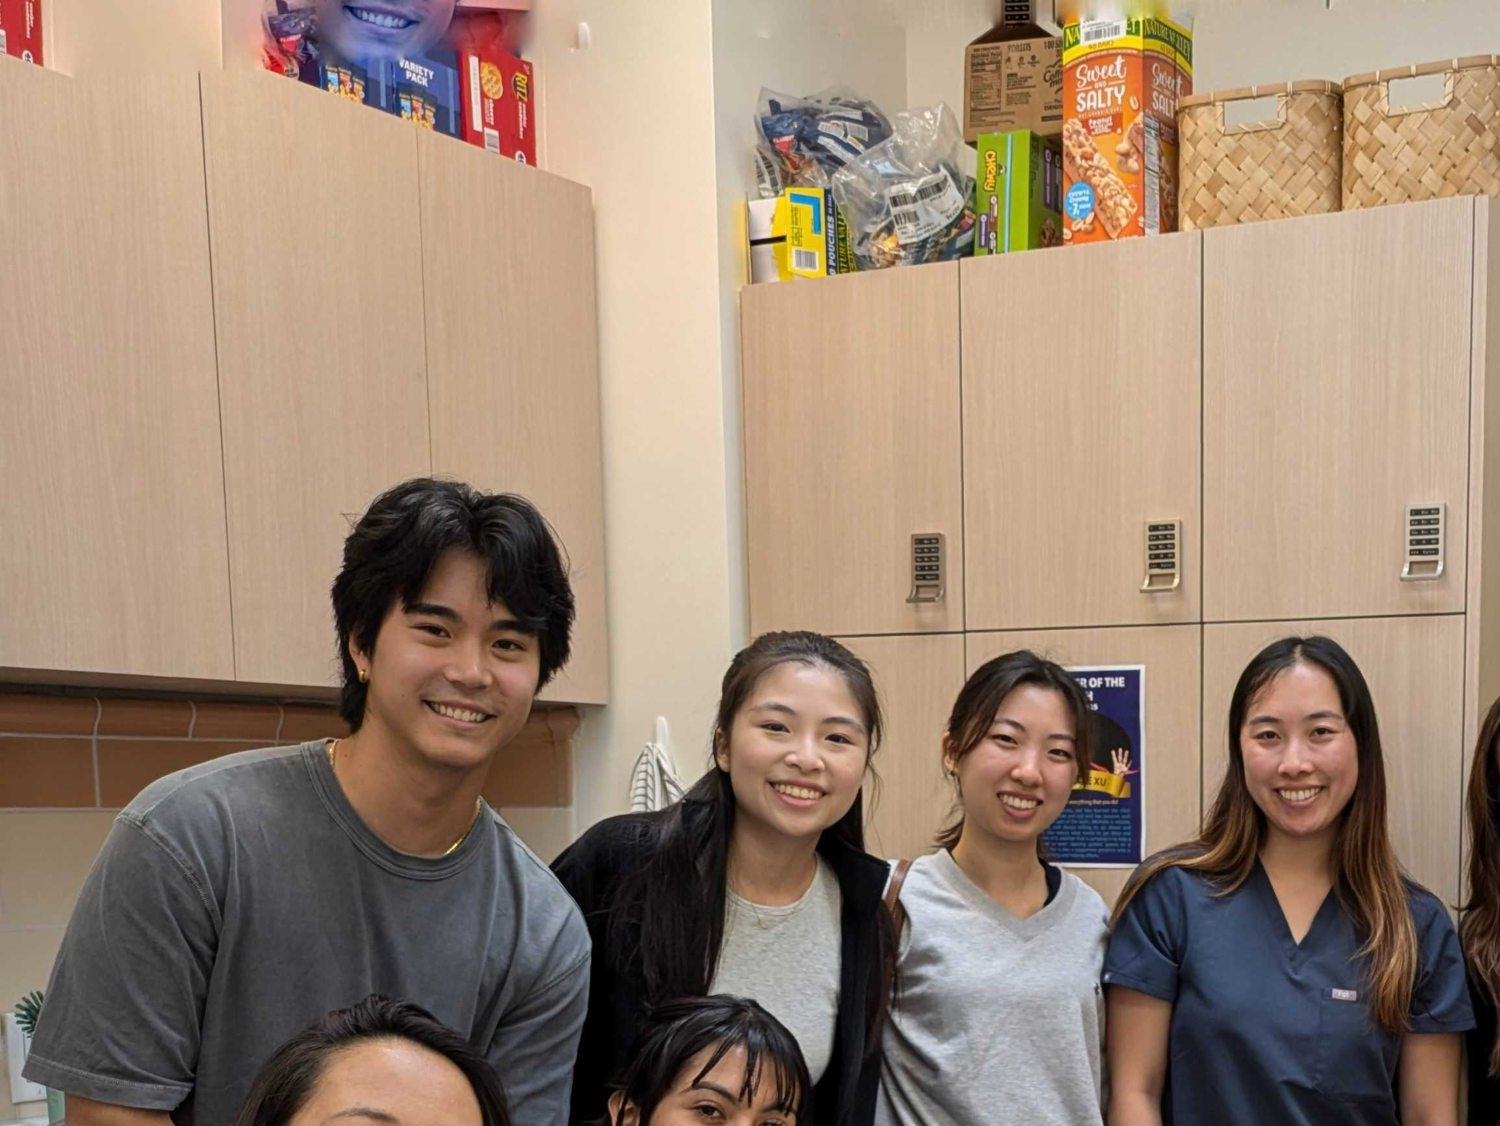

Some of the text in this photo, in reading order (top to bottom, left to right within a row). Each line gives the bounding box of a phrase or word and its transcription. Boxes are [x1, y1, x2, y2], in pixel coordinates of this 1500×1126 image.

[399, 57, 435, 80] VARIETY
[405, 71, 428, 87] PACK
[1075, 55, 1127, 89] Sweet
[514, 72, 529, 103] RITZ
[1076, 85, 1126, 113] SALTY
[826, 215, 836, 265] POUCHES
[1088, 676, 1104, 688] OF
[1104, 676, 1126, 688] THE
[1093, 776, 1107, 787] XU
